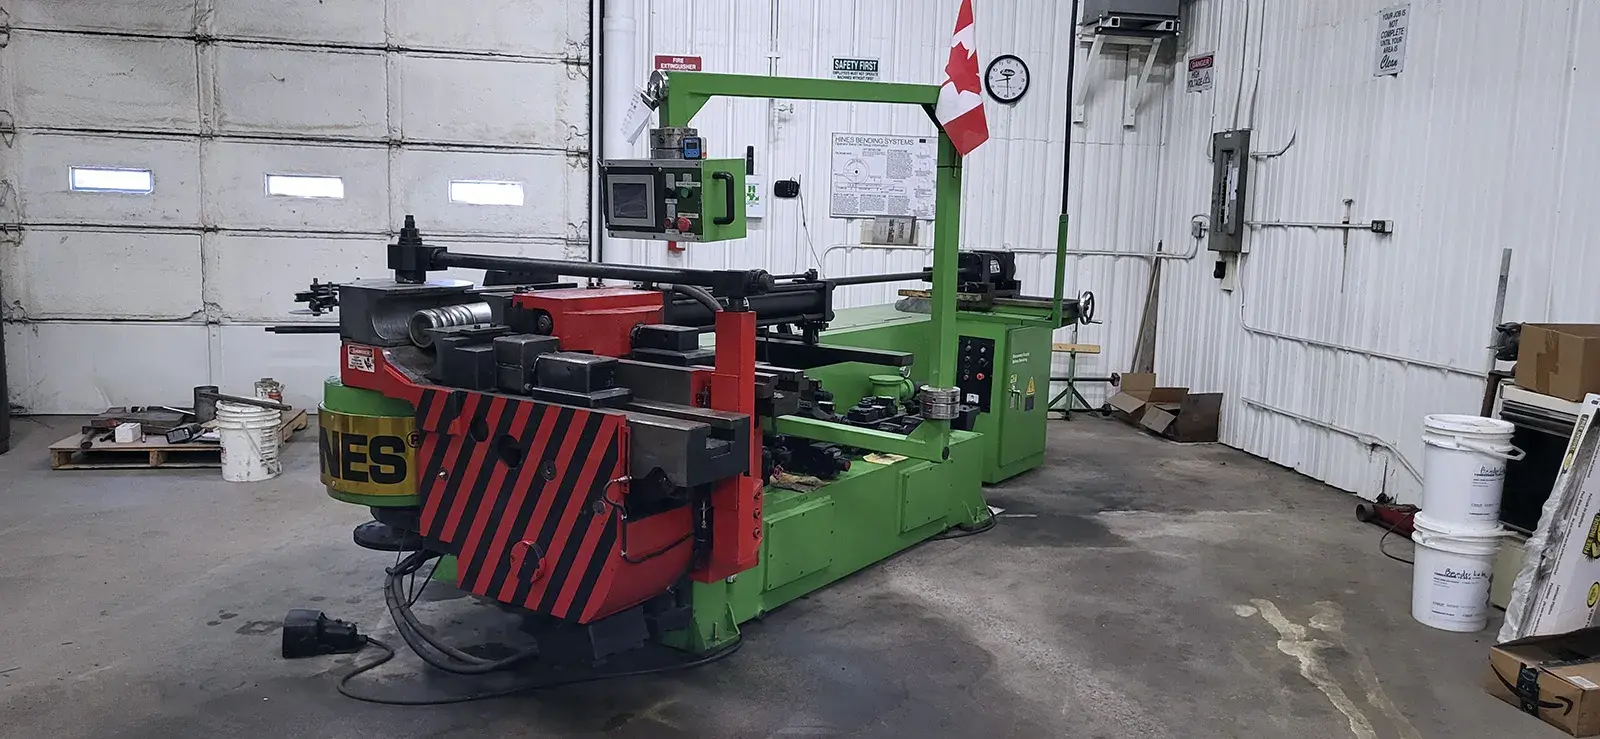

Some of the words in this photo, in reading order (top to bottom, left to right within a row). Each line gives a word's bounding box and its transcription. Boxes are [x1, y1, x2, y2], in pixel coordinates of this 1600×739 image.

[1393, 10, 1401, 18] JOB
[1389, 19, 1398, 28] NOT
[1381, 27, 1404, 39] COMPLETE
[834, 59, 858, 70] SAFETY
[859, 61, 877, 71] FIRST
[1191, 58, 1210, 69] DANGER
[1380, 54, 1398, 69] Clean
[1583, 538, 1593, 554] FREE
